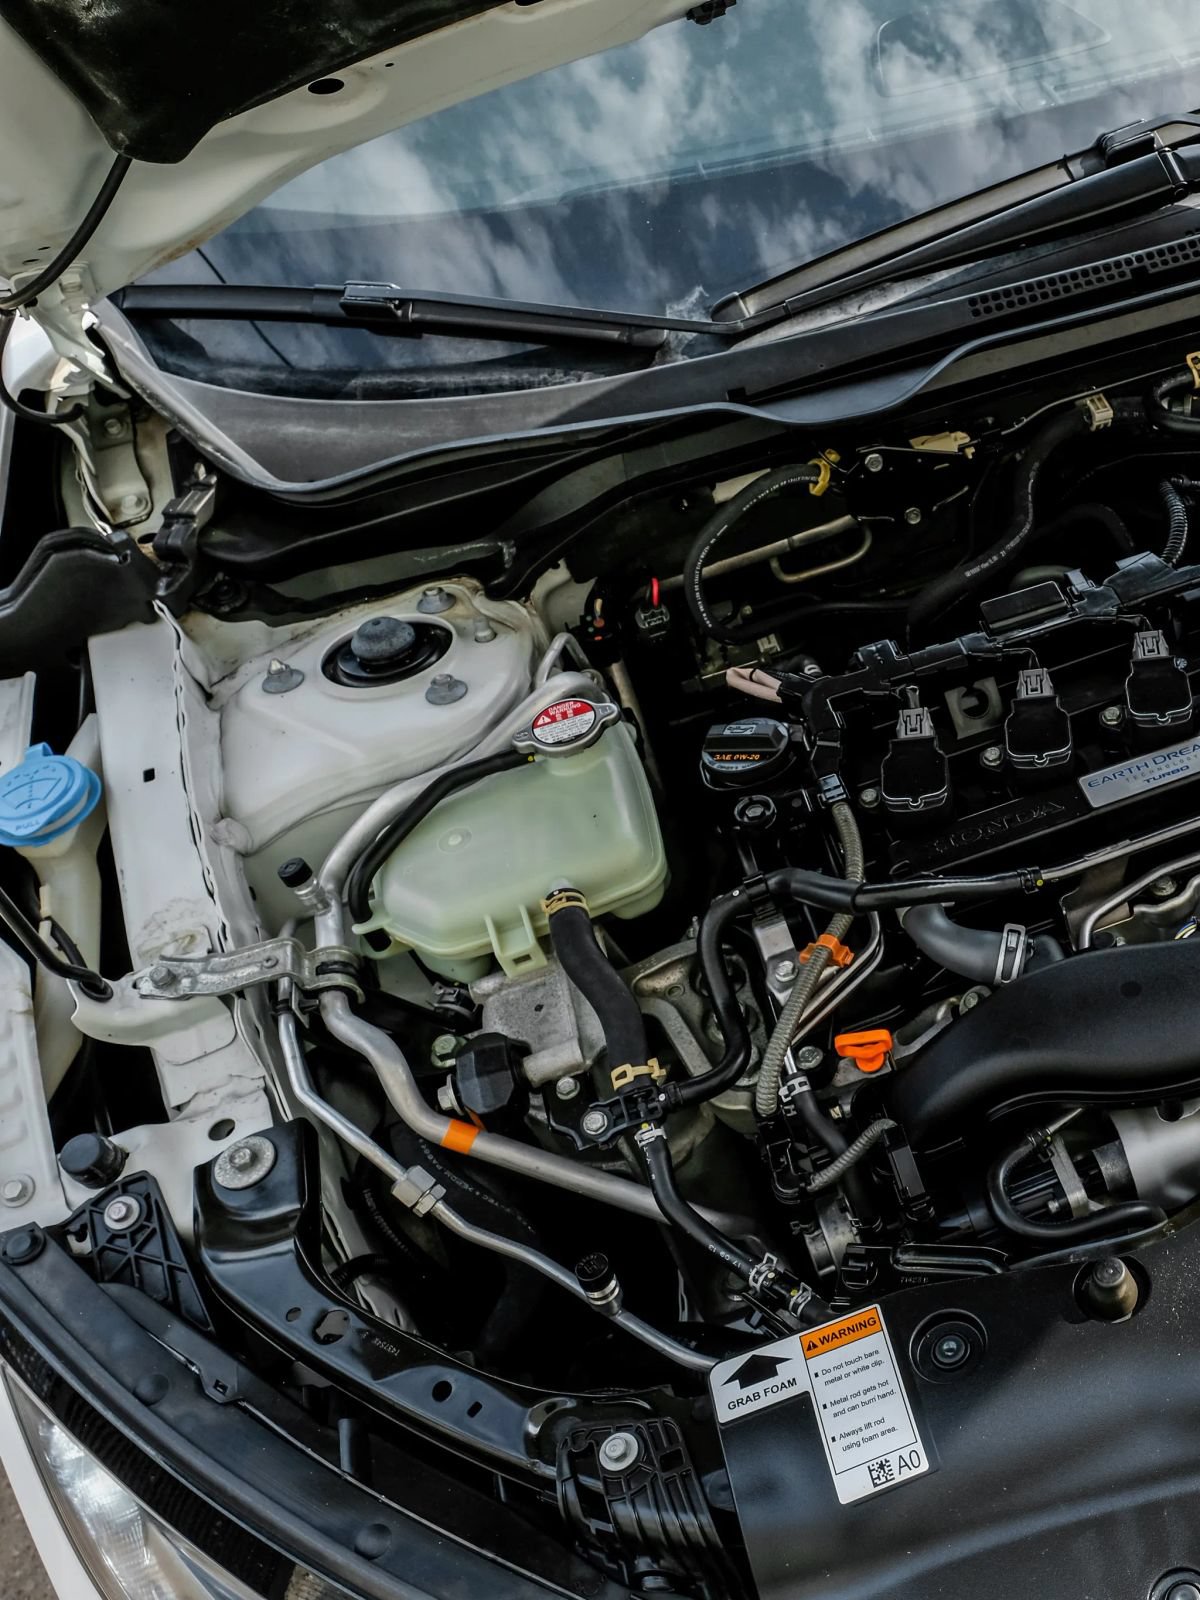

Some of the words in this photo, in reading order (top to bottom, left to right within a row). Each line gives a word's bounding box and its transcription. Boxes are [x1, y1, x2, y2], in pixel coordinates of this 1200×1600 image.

[1087, 762, 1150, 788] EARTH
[1125, 754, 1199, 783] TECHNOLOGY
[1143, 765, 1190, 784] TURBO
[15, 820, 39, 831] PULL
[819, 1317, 877, 1345] WARNING
[822, 1368, 831, 1376] Do
[833, 1363, 843, 1371] not
[845, 1355, 863, 1366] touch
[864, 1349, 879, 1359] bare
[825, 1375, 842, 1386] metal
[852, 1364, 870, 1374] white
[871, 1360, 884, 1369] clip.
[728, 1391, 761, 1410] GRAB
[763, 1377, 797, 1397] FOAM
[830, 1394, 848, 1407] Metal
[850, 1391, 860, 1399] rod
[863, 1386, 876, 1396] gets
[878, 1380, 889, 1388] hot
[833, 1408, 846, 1418] and
[847, 1403, 859, 1412] can
[861, 1397, 876, 1407] burn
[877, 1389, 896, 1400] hand.
[839, 1426, 863, 1440] Always
[864, 1422, 873, 1430] lift
[874, 1417, 885, 1426] rod
[842, 1441, 860, 1452] using
[861, 1433, 879, 1444] foam
[880, 1426, 898, 1436] area.
[898, 1449, 921, 1475] A0
